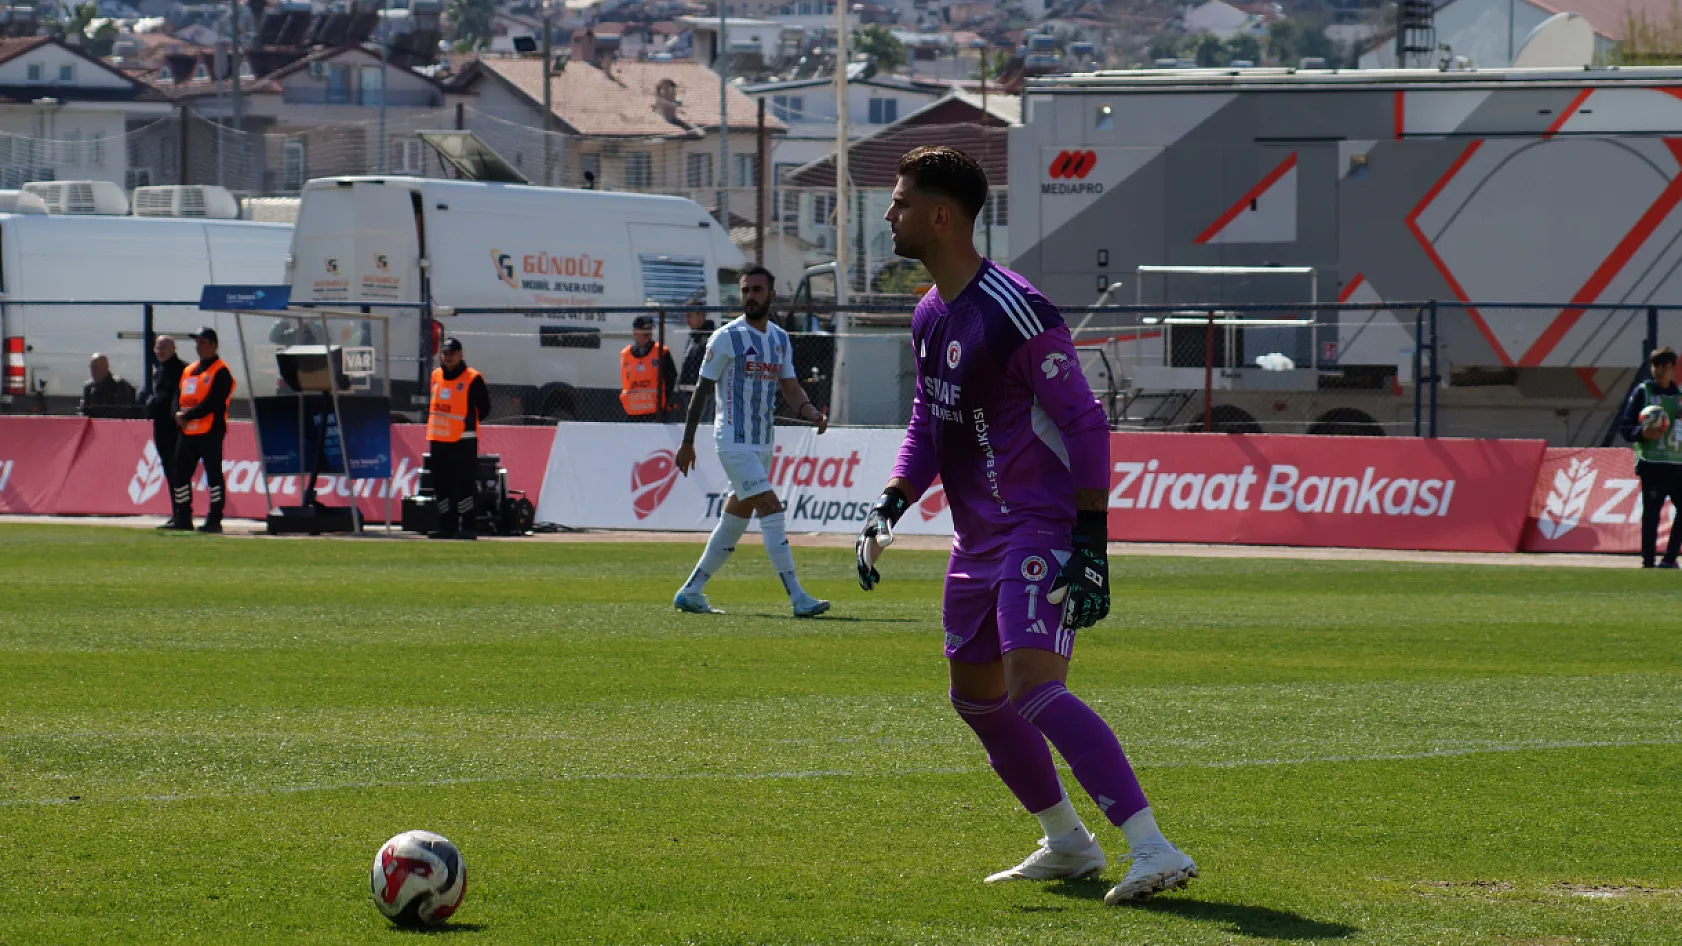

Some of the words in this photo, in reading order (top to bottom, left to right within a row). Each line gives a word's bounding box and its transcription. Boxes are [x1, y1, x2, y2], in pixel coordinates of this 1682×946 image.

[1041, 182, 1104, 194] MEDIAPRO
[522, 251, 605, 278] GÜNDÜZ
[522, 279, 551, 291] MOBİL
[553, 281, 605, 294] JENERATÖR
[346, 354, 371, 370] VAR
[746, 361, 779, 373] ESNA
[925, 376, 962, 406] SNAF
[767, 446, 861, 488] iraat
[1108, 459, 1257, 510] Ziraat
[1260, 464, 1456, 517] Bankası
[1025, 584, 1040, 620] 1
